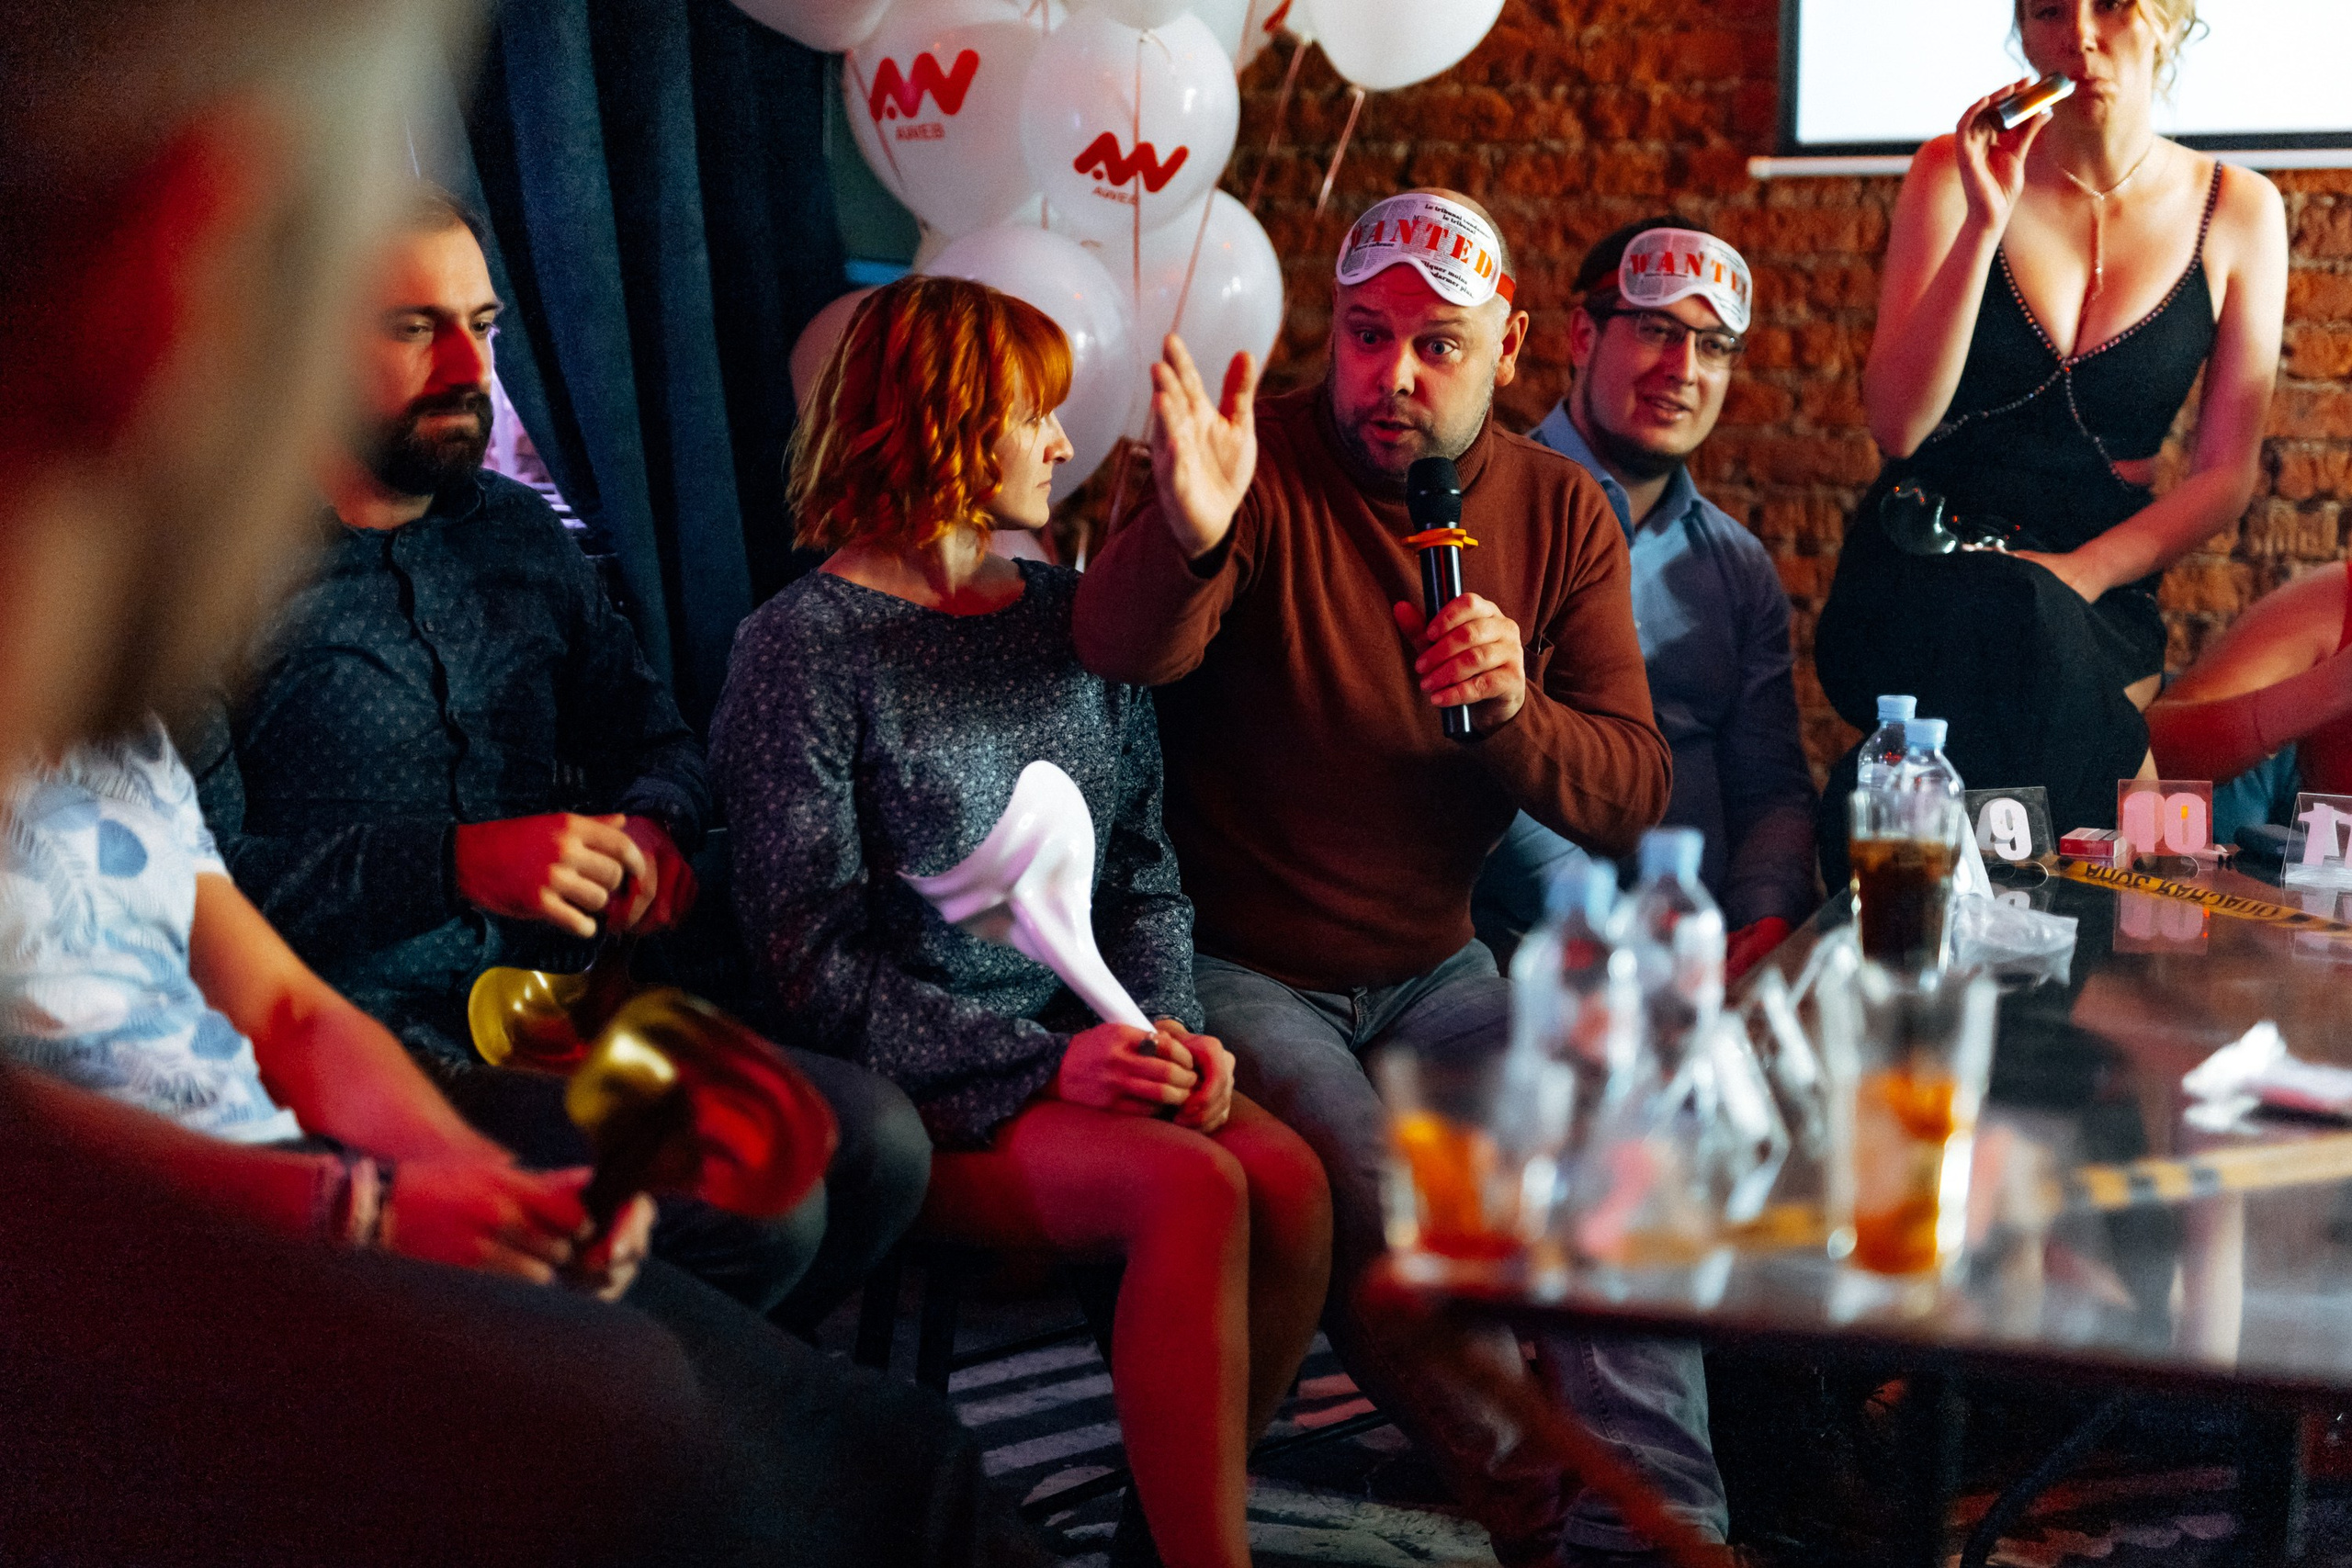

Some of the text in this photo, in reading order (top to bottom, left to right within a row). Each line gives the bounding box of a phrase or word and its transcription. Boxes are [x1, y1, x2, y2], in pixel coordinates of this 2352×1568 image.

[896, 122, 945, 141] AWEB
[1350, 219, 1494, 279] WANTED
[1989, 799, 2032, 861] 9
[2157, 881, 2279, 917] ОПАСНАЯ
